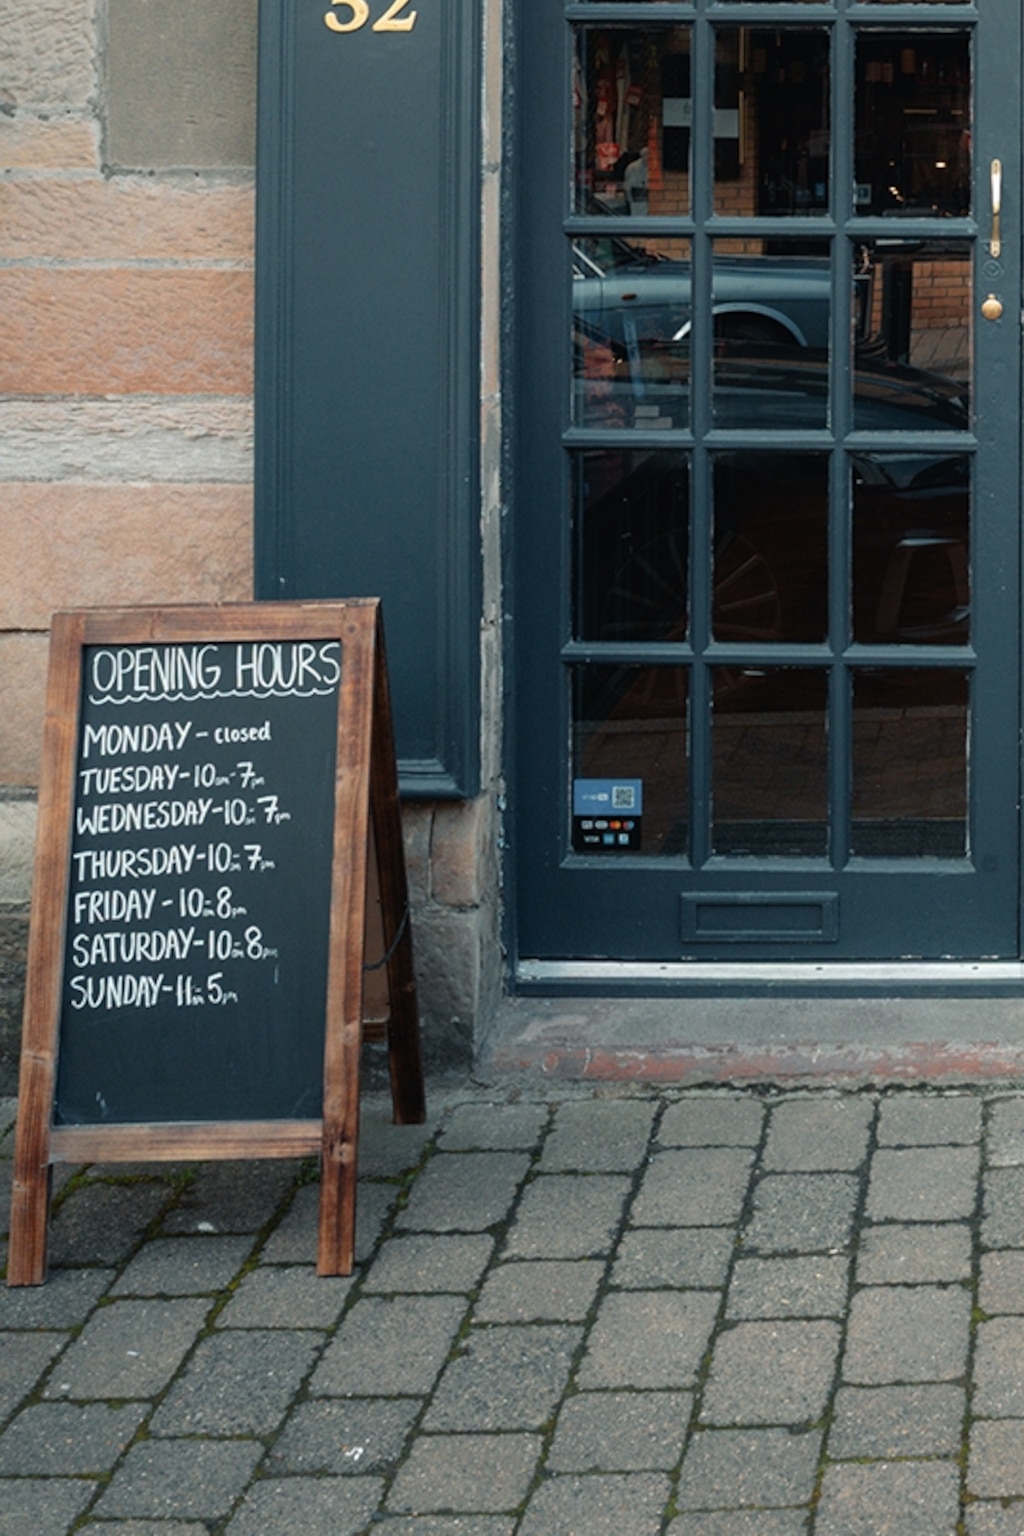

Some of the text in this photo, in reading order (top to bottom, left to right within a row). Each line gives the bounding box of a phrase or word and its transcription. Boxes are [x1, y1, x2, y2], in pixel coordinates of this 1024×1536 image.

[92, 642, 341, 693] OPENING HOURS
[82, 721, 193, 758] MONDAY
[213, 720, 272, 744] closed
